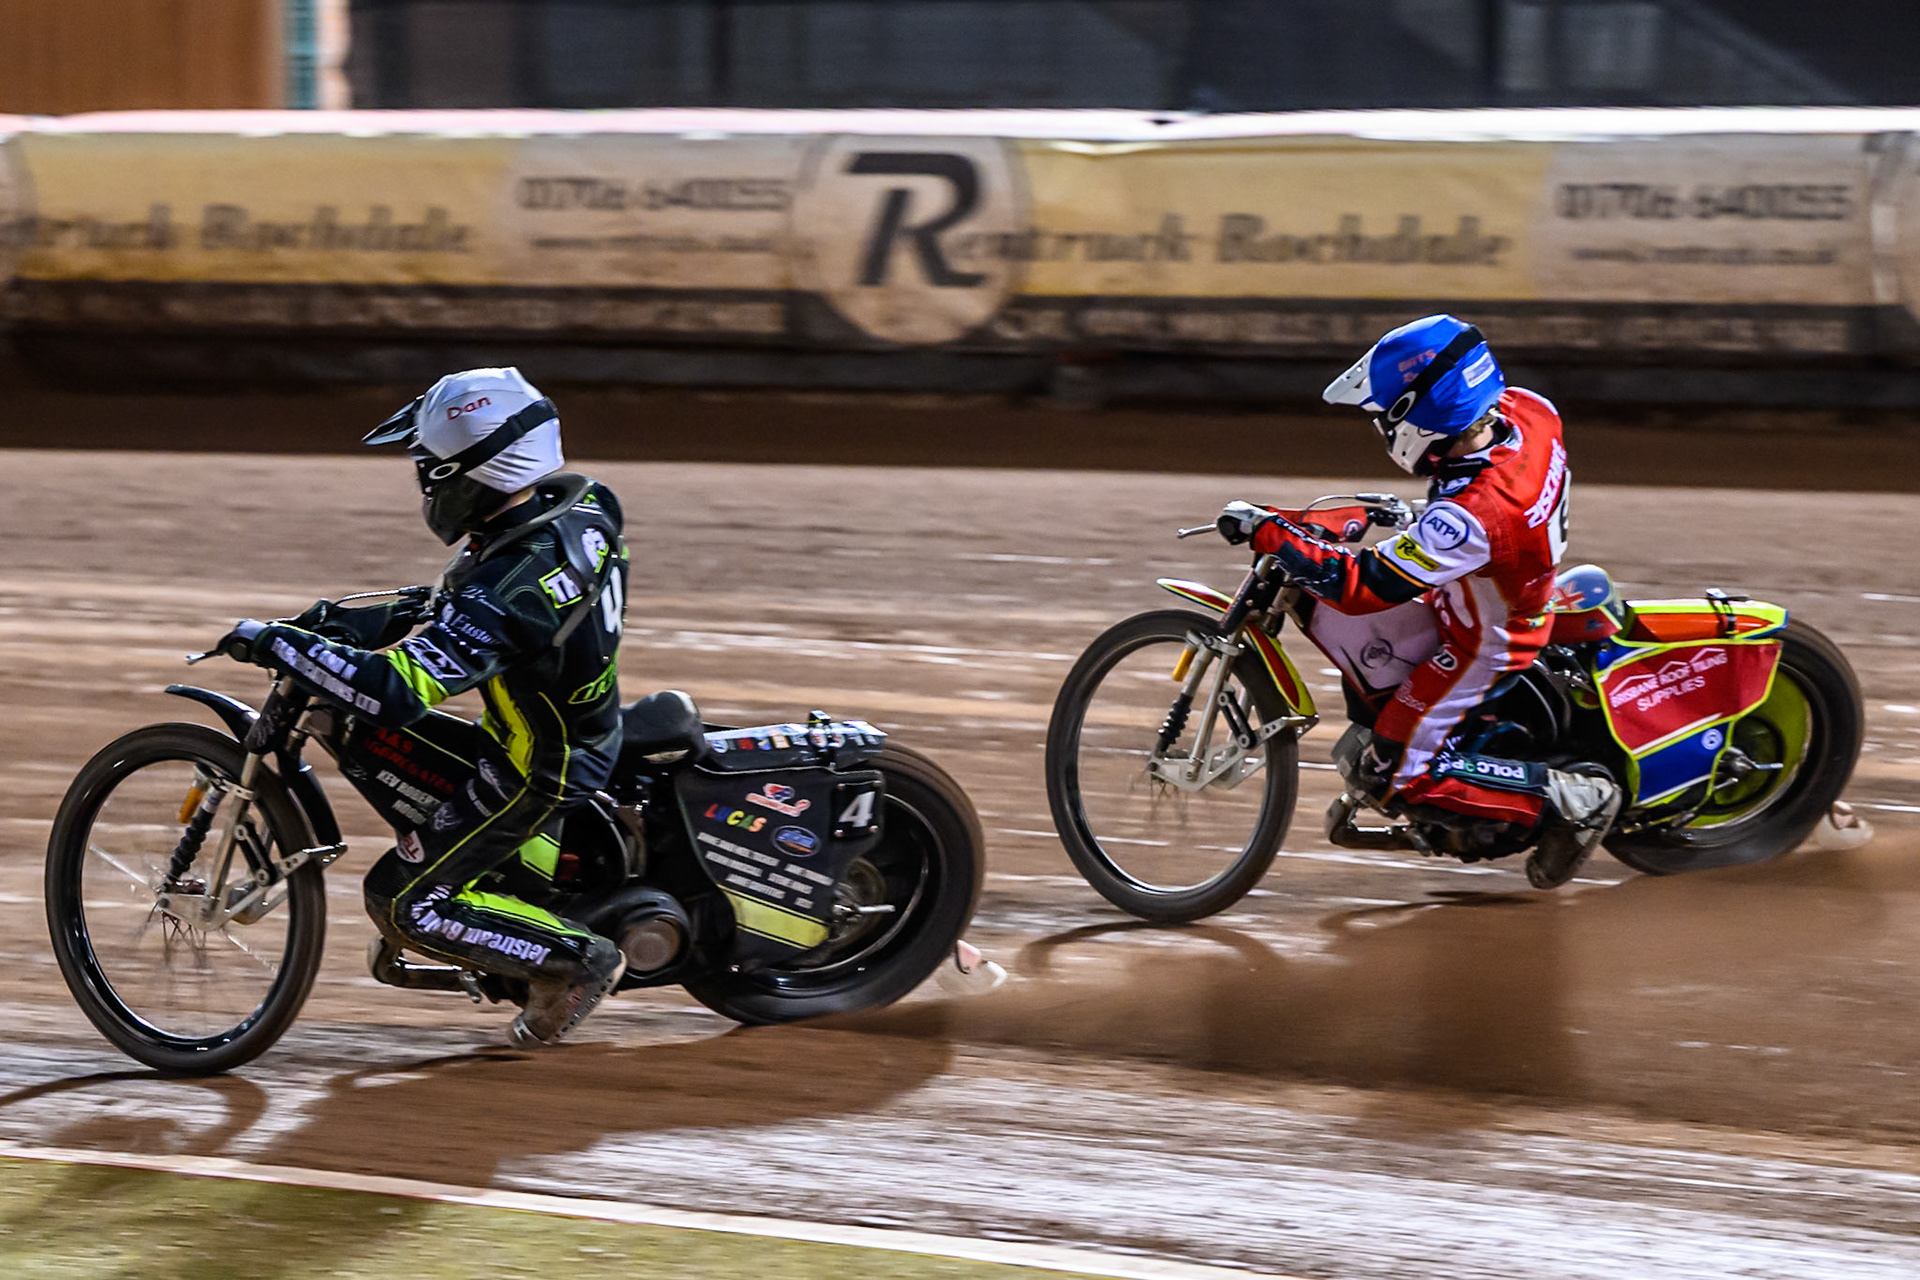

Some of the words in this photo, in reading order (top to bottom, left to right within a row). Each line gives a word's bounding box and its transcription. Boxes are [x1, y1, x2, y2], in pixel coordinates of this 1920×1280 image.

[446, 396, 491, 421] Dan
[1425, 516, 1461, 541] ATPI
[1610, 676, 1659, 708] BRISBANE
[1658, 665, 1690, 686] ROOF
[1636, 676, 1706, 712] SUPPLIES
[704, 803, 768, 833] LUCAS
[838, 791, 876, 828] 4
[461, 928, 552, 966] Jetstream
